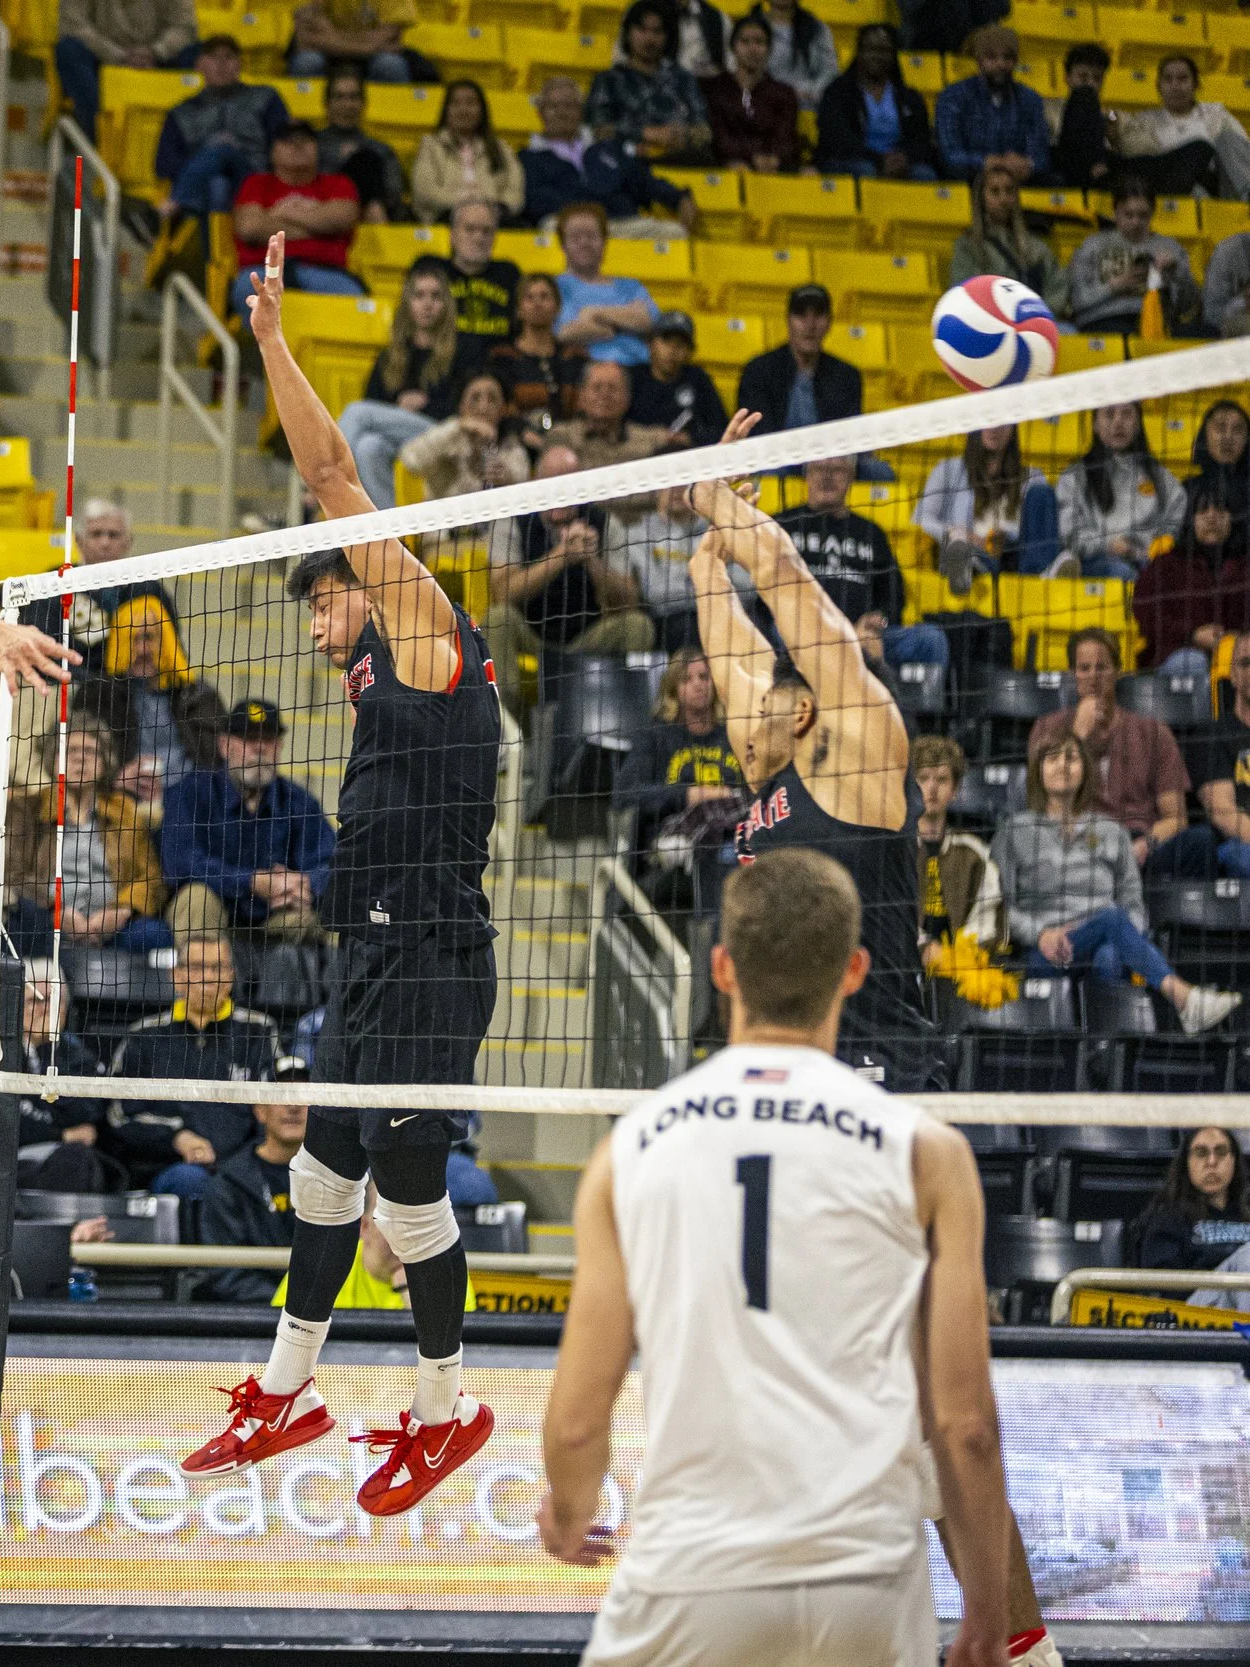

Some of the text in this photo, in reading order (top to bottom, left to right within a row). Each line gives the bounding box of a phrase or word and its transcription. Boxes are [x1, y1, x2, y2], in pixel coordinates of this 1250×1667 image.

[638, 1096, 882, 1151] LONG BEACH
[735, 1154, 773, 1311] 1
